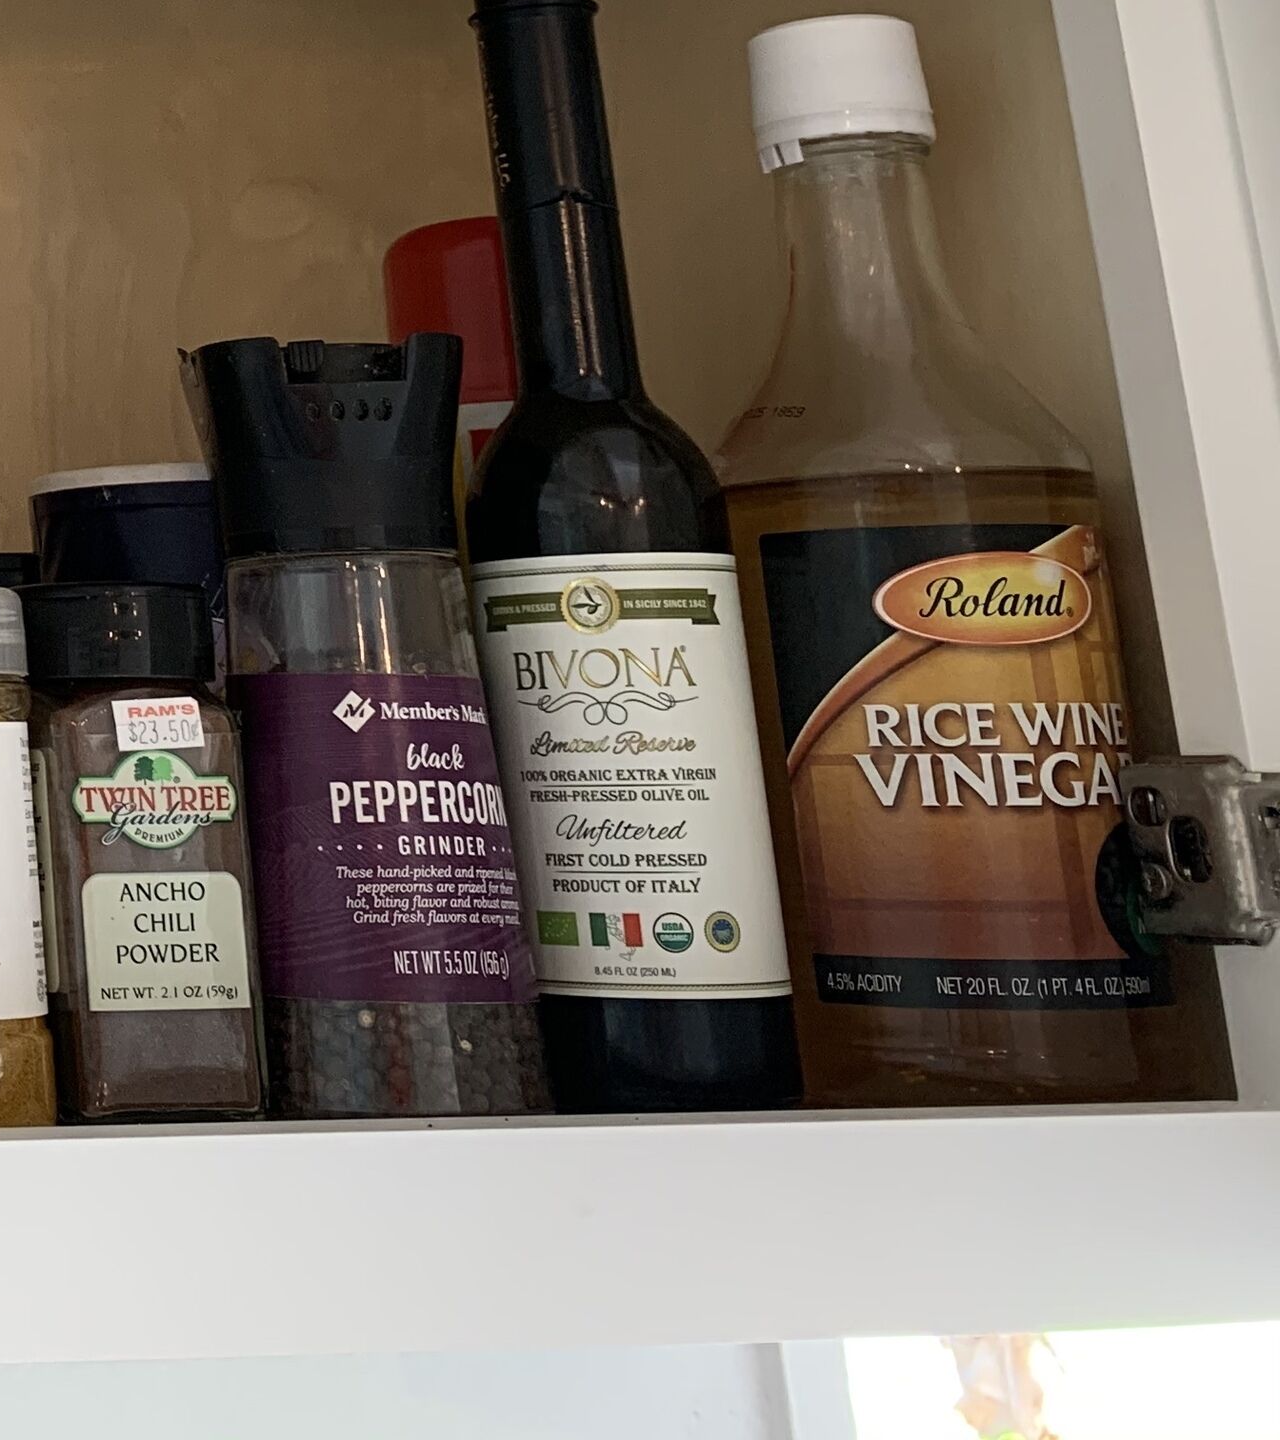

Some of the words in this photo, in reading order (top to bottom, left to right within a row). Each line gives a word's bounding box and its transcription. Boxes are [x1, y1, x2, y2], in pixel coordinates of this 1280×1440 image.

[919, 577, 1066, 618] Roland
[513, 645, 697, 690] BIVONA
[127, 704, 196, 719] RAM'S
[379, 702, 460, 721] Member's
[863, 703, 1000, 748] RICE
[1009, 702, 1127, 746] WINE
[531, 731, 609, 756] Limited
[613, 731, 696, 755] Reserve
[407, 743, 464, 770] black
[521, 770, 547, 782] 100%
[550, 769, 611, 782] ORGANIC
[616, 769, 667, 780] EXTRA
[671, 768, 716, 780] VIRGIN
[853, 751, 1131, 807] VINEGA
[80, 786, 156, 812] TWIN
[160, 786, 231, 811] TREE
[531, 789, 637, 802] FRESH-PRESSED
[642, 789, 684, 801] OLIVE
[688, 789, 709, 800] OIL
[102, 802, 213, 845] Gardens
[556, 814, 687, 846] Unfiltered
[134, 829, 184, 843] PREMIUM
[398, 836, 486, 856] GRINDER
[546, 854, 584, 867] FIRST
[589, 854, 630, 867] COLD
[636, 854, 707, 866] PRESSED
[336, 867, 373, 879] These
[377, 866, 452, 879] hand-picked
[455, 867, 474, 878] and
[120, 882, 205, 902] ANCHO
[357, 882, 433, 896] peppercorns
[437, 883, 455, 892] are
[458, 882, 486, 895] prized
[553, 879, 620, 893] PRODUCT
[626, 880, 645, 893] OF
[652, 878, 700, 893] ITALY
[346, 897, 369, 909] hot,
[374, 896, 408, 910] biting
[411, 896, 447, 910] flavor
[450, 897, 470, 908] and
[473, 898, 499, 908] robust
[134, 913, 196, 933] CHILI
[354, 911, 390, 924] Grind
[392, 910, 424, 926] fresh
[427, 910, 466, 926] flavors
[116, 944, 219, 964] POWDER
[827, 976, 855, 990] 4.5%
[857, 976, 902, 992] ACIDITY
